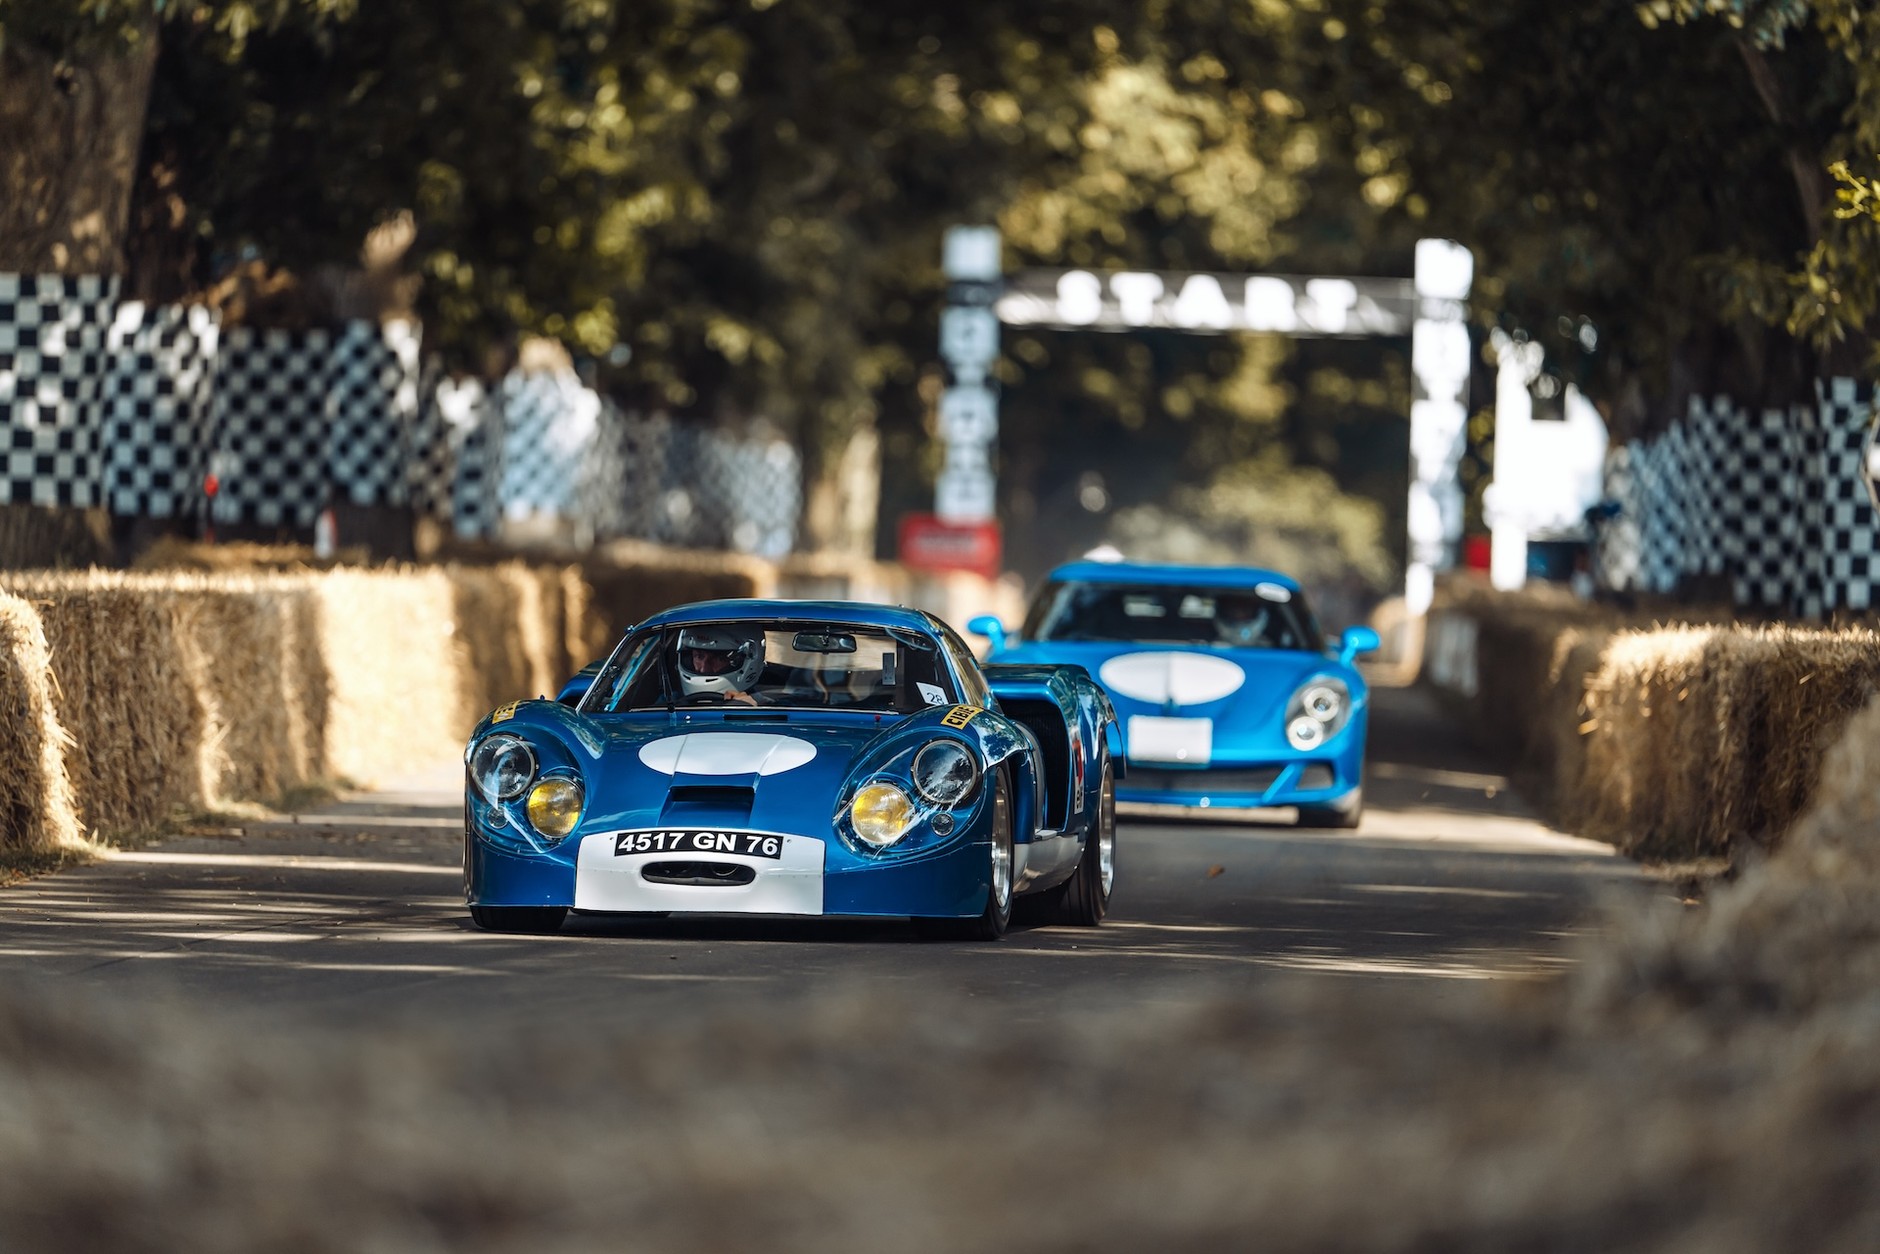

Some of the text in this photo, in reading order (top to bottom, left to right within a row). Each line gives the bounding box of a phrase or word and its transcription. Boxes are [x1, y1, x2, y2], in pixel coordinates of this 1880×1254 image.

[1056, 269, 1357, 332] START
[926, 691, 945, 705] 28
[618, 832, 779, 856] 4517 GN 76
